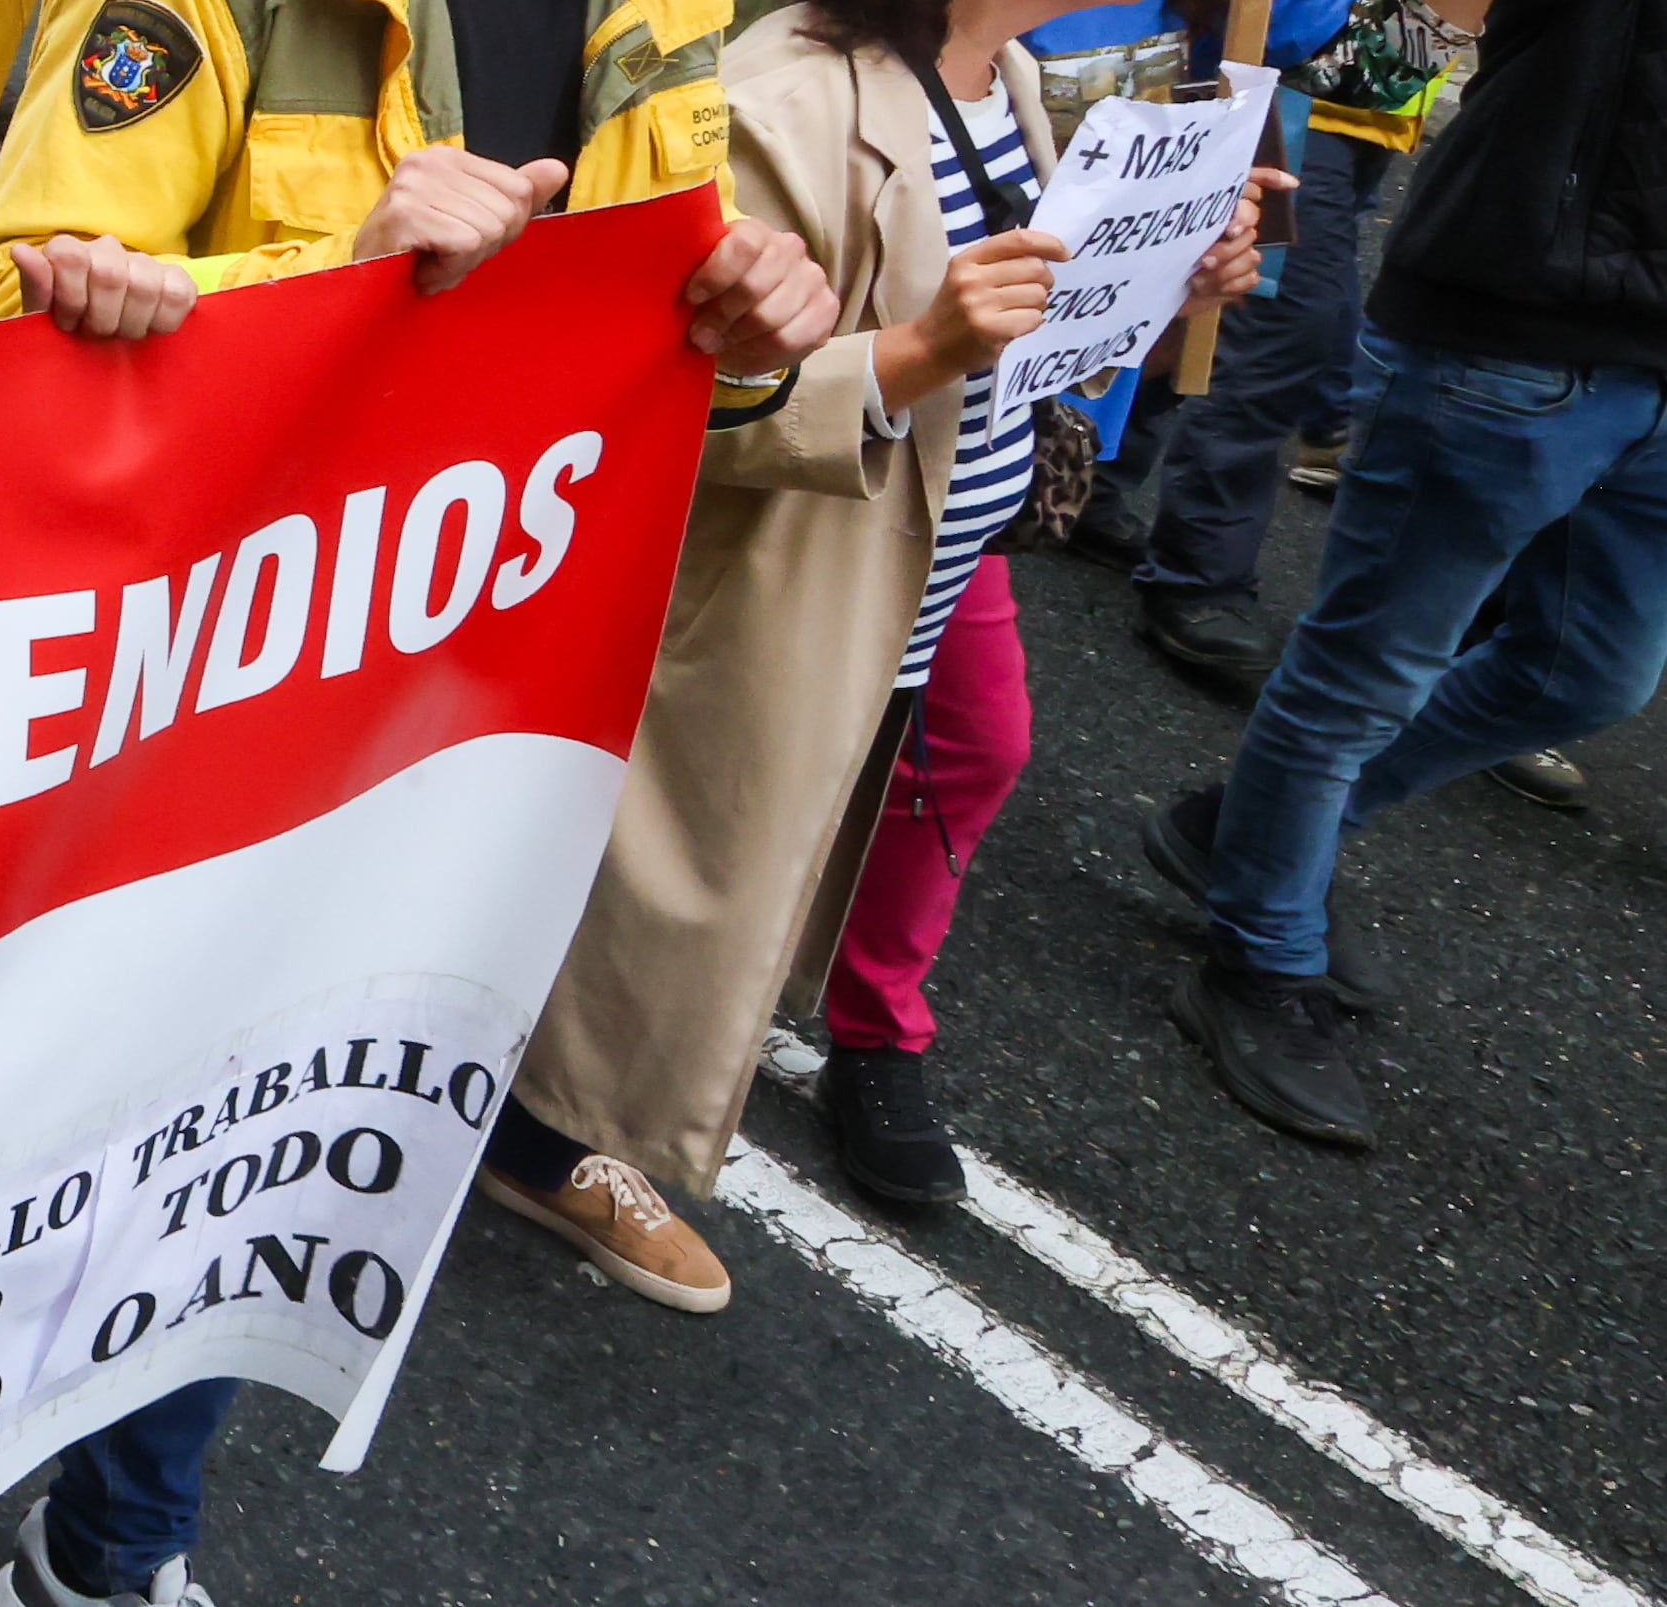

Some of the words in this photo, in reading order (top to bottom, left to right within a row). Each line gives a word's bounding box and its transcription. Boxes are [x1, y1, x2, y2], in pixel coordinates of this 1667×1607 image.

[1120, 121, 1212, 180] MÁIS
[133, 1037, 497, 1188] TRABALLO
[158, 1126, 404, 1240] TODO
[90, 1291, 156, 1363] O
[166, 1233, 406, 1341] ANO
